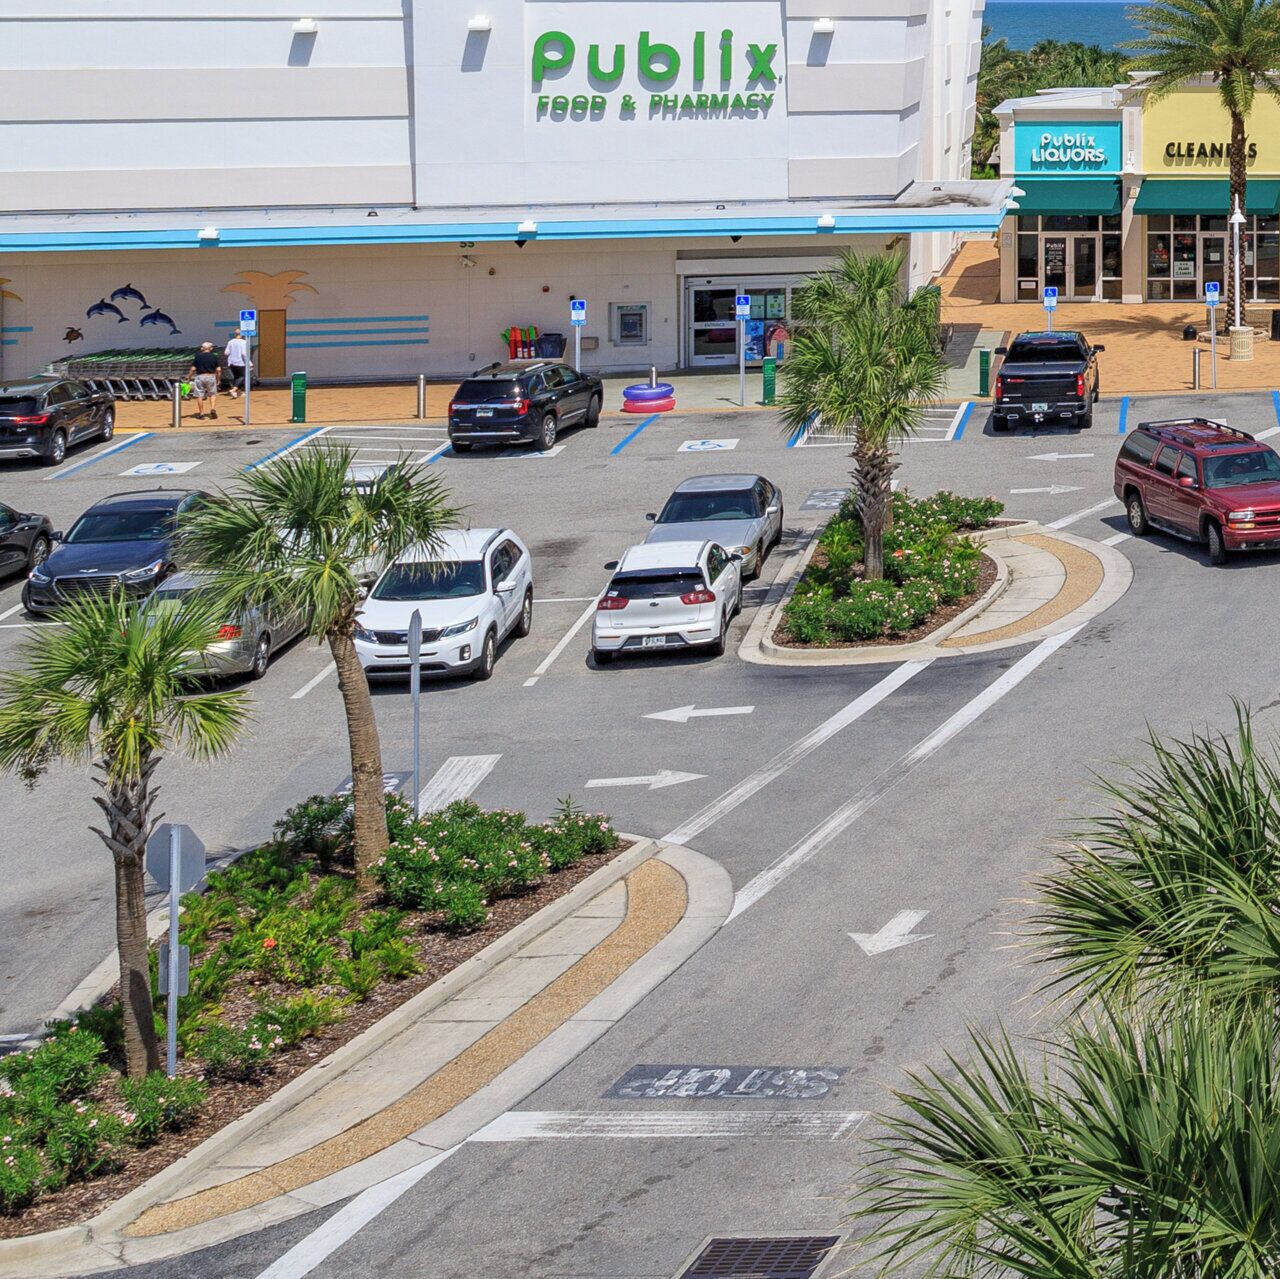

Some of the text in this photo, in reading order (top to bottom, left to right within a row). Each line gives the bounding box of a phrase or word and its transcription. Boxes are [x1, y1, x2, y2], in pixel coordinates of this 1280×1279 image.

[533, 29, 778, 81] Publix
[537, 93, 775, 111] FOOD & PHARMACY
[1040, 133, 1096, 146] Publix
[1032, 148, 1105, 163] LIQUORS
[1165, 142, 1258, 159] CLEANES
